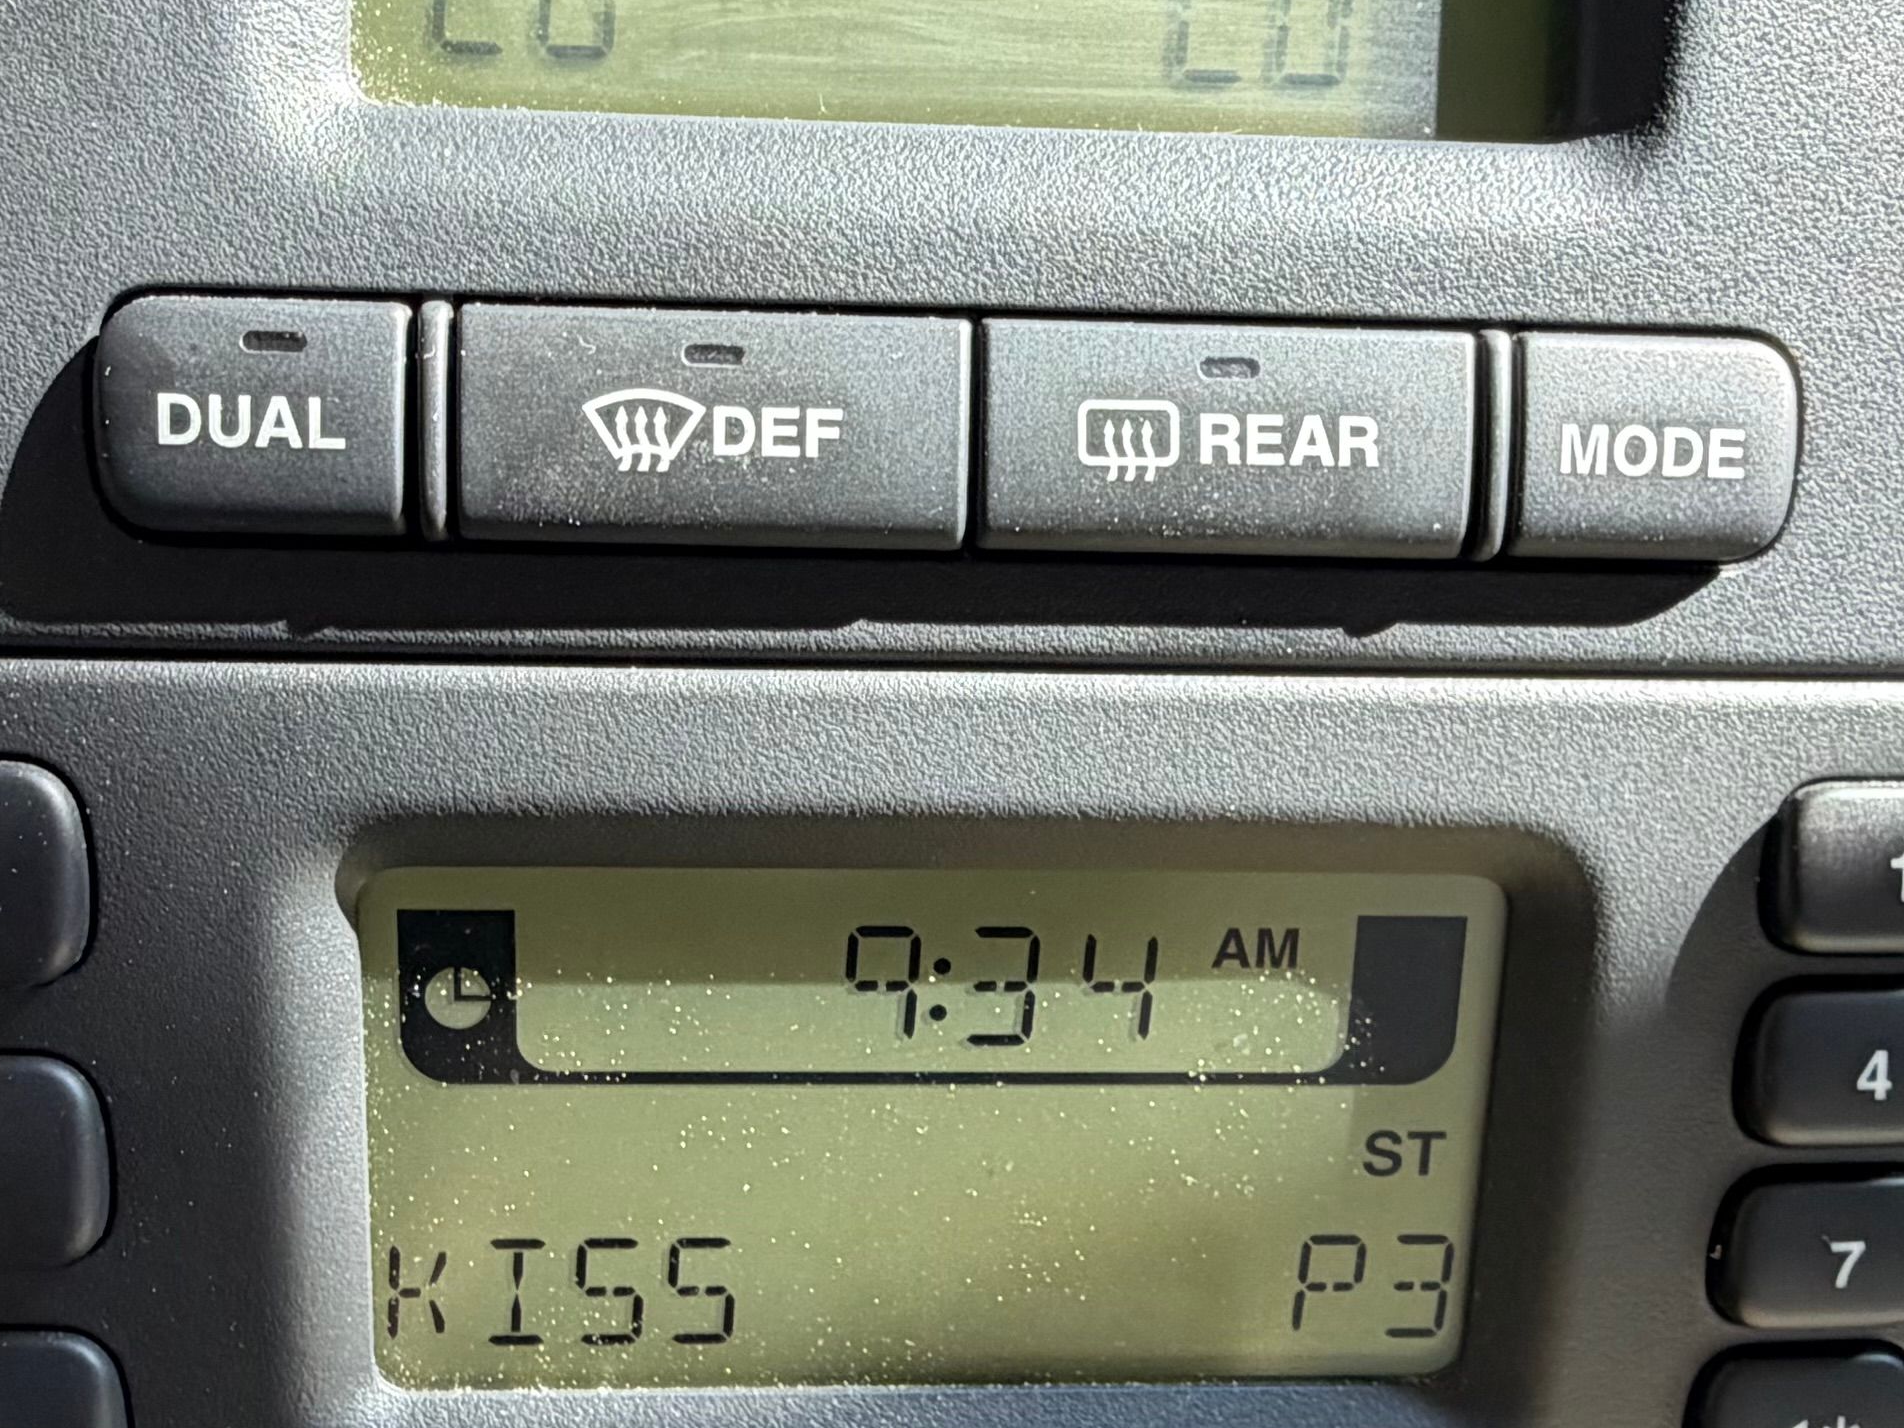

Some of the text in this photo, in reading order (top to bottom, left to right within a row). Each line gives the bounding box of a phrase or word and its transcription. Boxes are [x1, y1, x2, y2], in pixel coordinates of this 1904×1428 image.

[156, 391, 348, 451] DUAL
[711, 403, 845, 462] DEF
[1198, 411, 1381, 469] REAR
[1558, 422, 1747, 480] MODE
[844, 923, 1302, 1048] 9:34 AM
[1855, 1048, 1894, 1102] 4
[1361, 1128, 1449, 1178] ST
[386, 1232, 1456, 1348] KISS P3
[1830, 1239, 1867, 1290] 7
